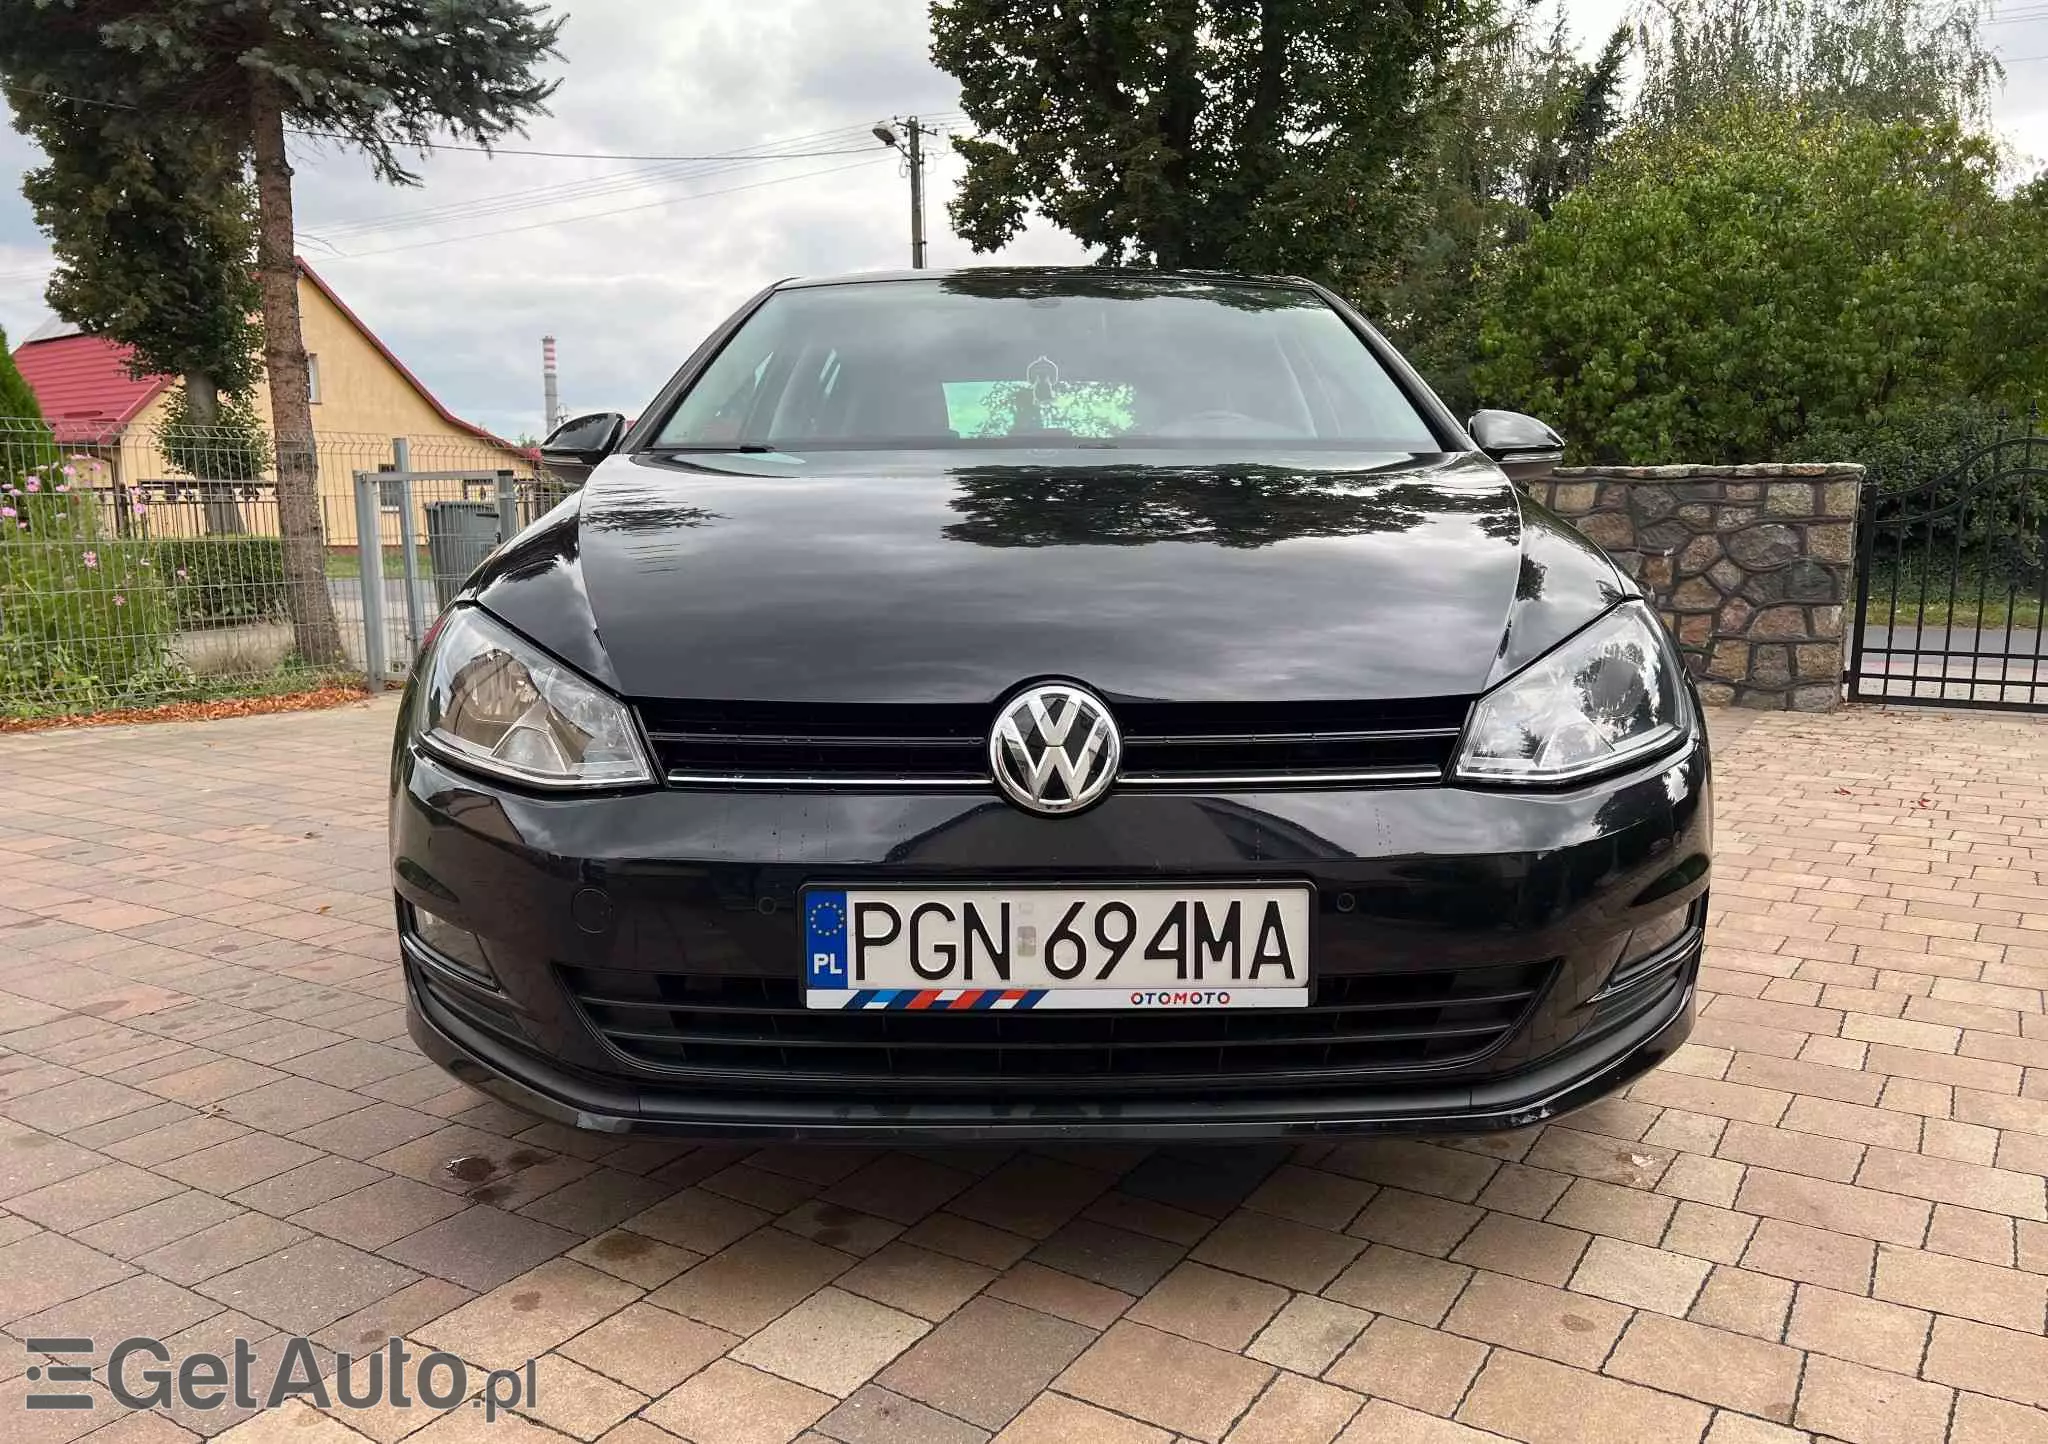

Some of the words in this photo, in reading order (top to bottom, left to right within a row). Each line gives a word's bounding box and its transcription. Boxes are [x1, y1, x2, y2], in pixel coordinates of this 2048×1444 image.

[853, 901, 1011, 981] PGN
[1043, 900, 1296, 981] 694MA
[813, 953, 843, 975] PL
[1130, 991, 1231, 1006] OTOMOTO
